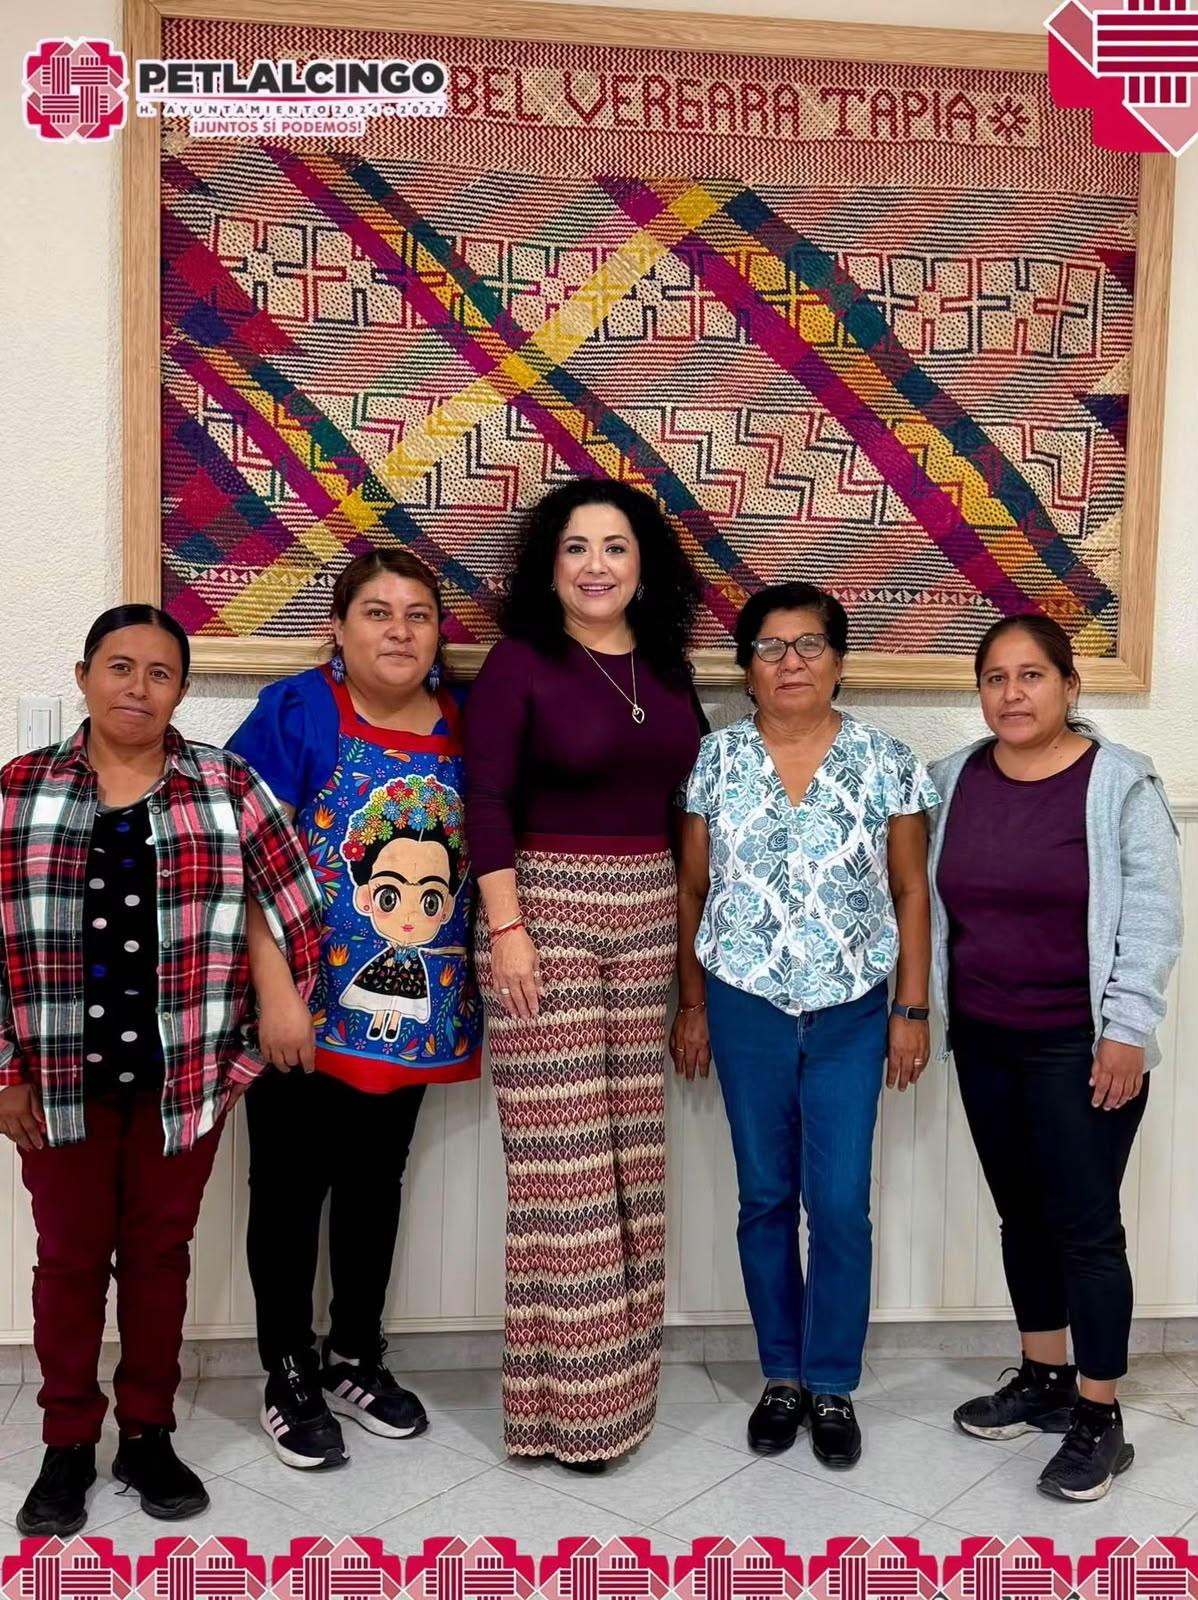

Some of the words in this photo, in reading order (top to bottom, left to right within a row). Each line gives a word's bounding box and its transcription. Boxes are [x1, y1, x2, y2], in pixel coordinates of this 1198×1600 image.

[451, 66, 543, 122] BEL
[563, 70, 800, 138] VERGARA
[819, 88, 976, 140] TAPIA
